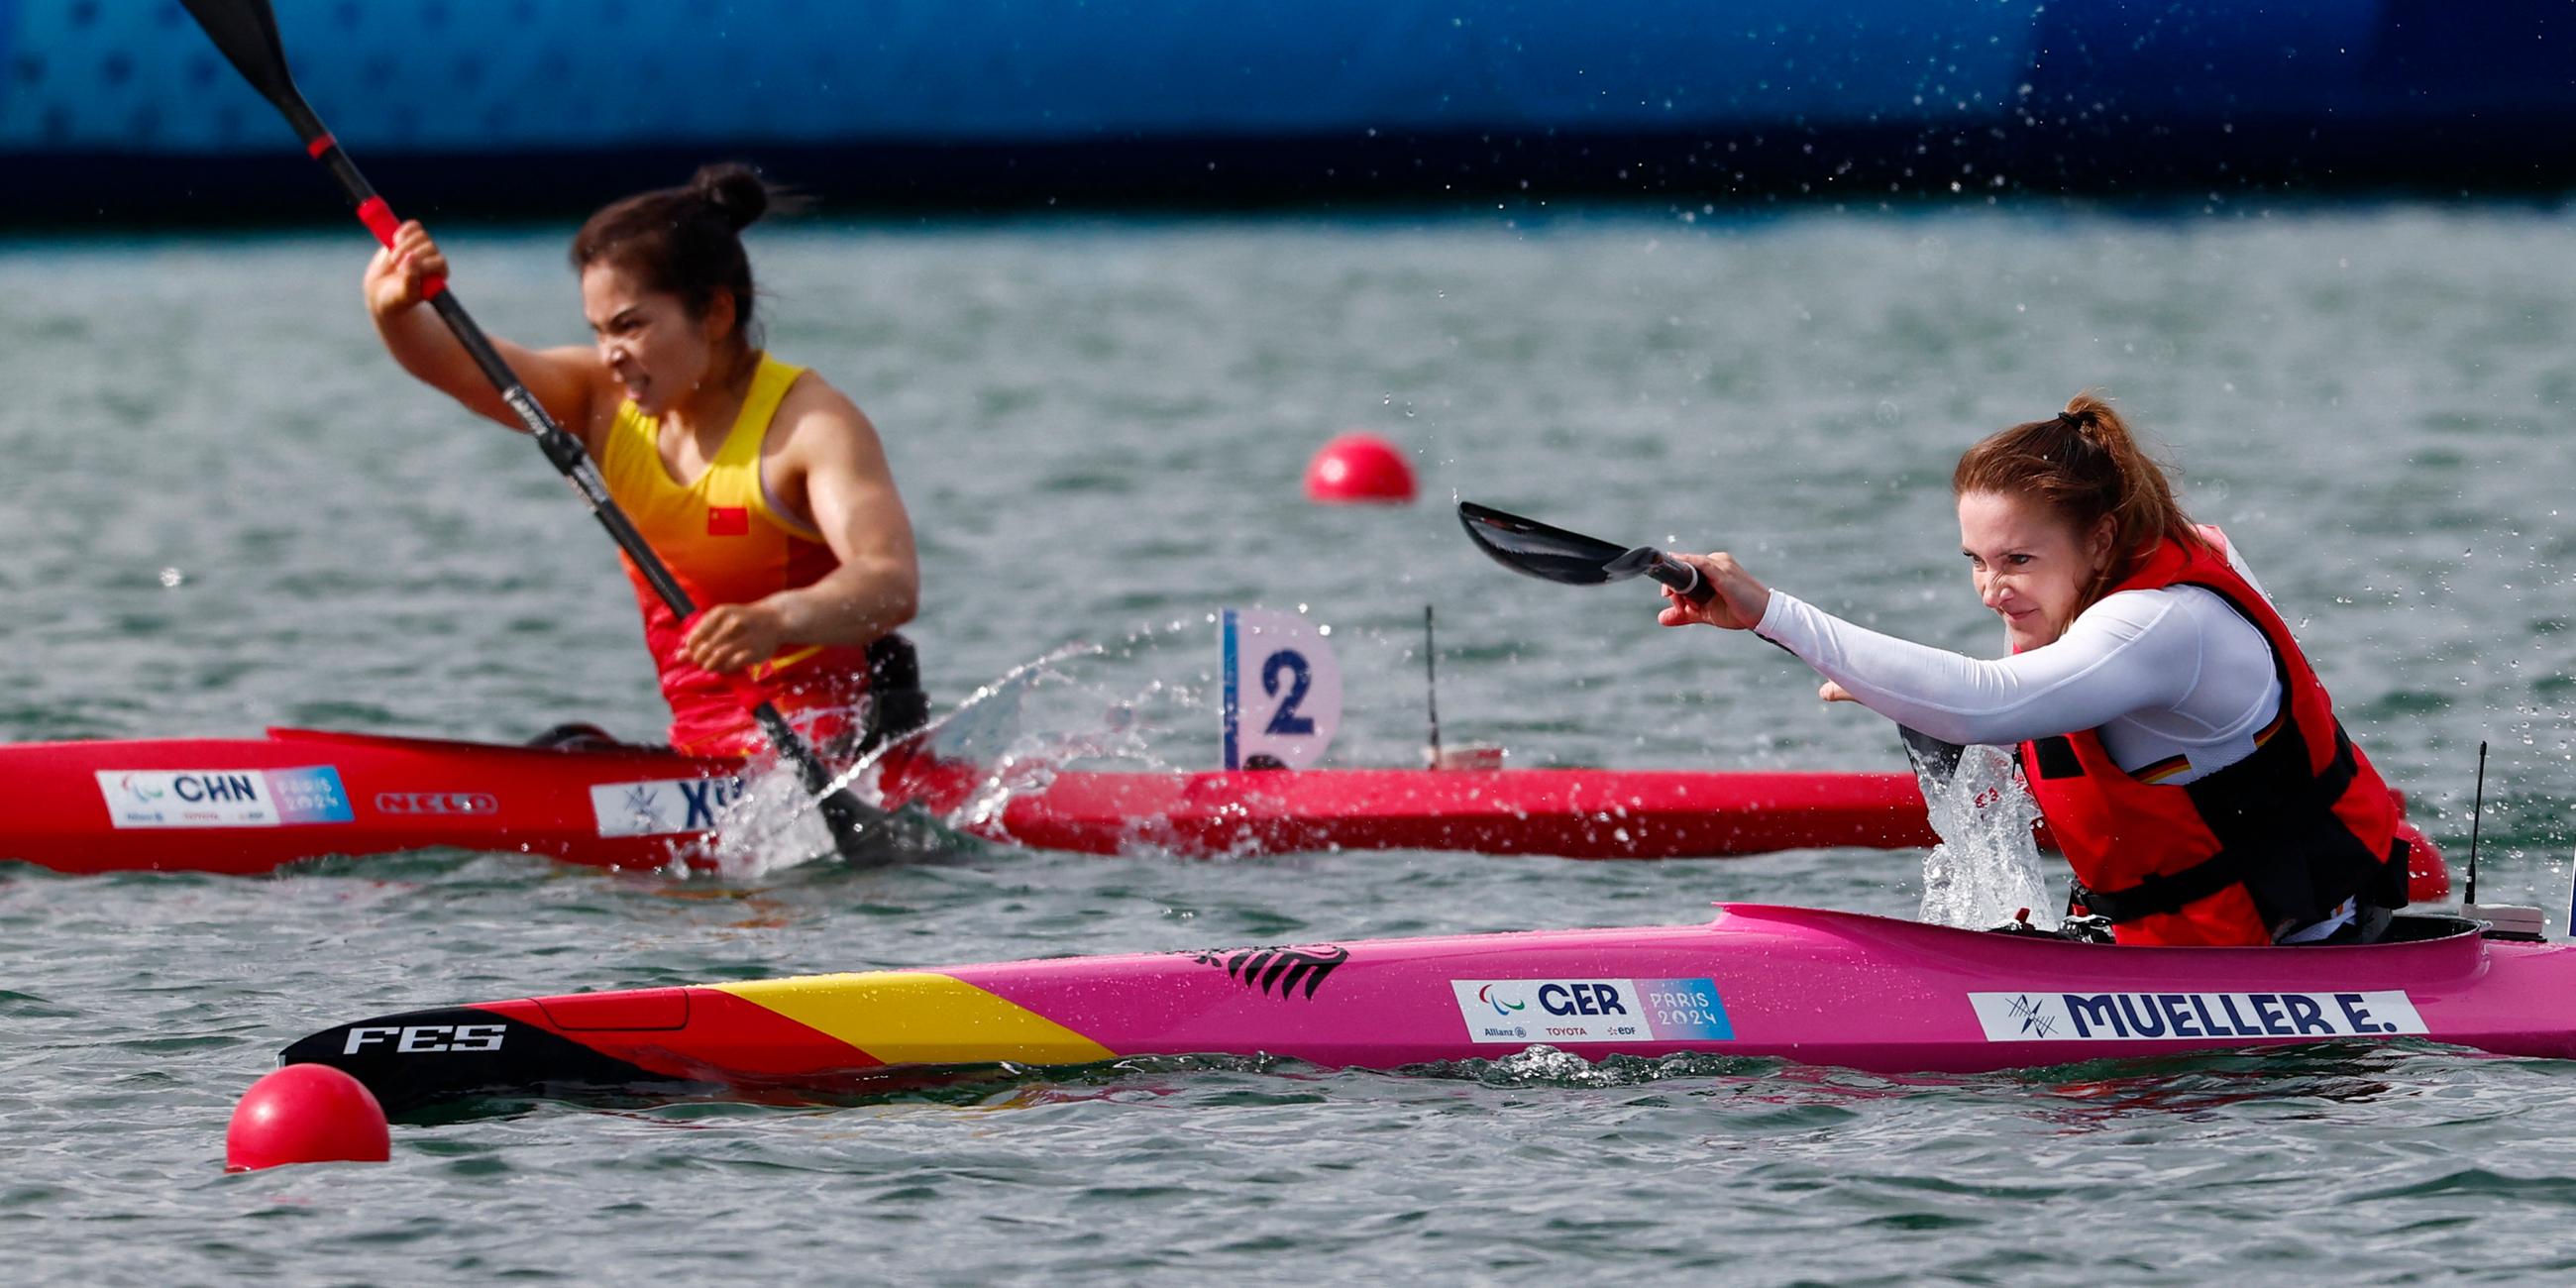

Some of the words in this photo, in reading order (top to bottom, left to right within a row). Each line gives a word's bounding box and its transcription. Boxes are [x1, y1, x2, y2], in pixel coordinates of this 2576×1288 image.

[1262, 647, 1314, 735] 2
[173, 775, 258, 803] CHN
[1538, 983, 1627, 1016] GER
[1658, 1010, 1717, 1024] 2024
[2063, 994, 2336, 1037] MUELLER
[2333, 993, 2398, 1033] E.
[343, 1024, 507, 1055] FES
[1484, 1027, 1514, 1036] Allianz
[1546, 1027, 1587, 1036] TOYOTA
